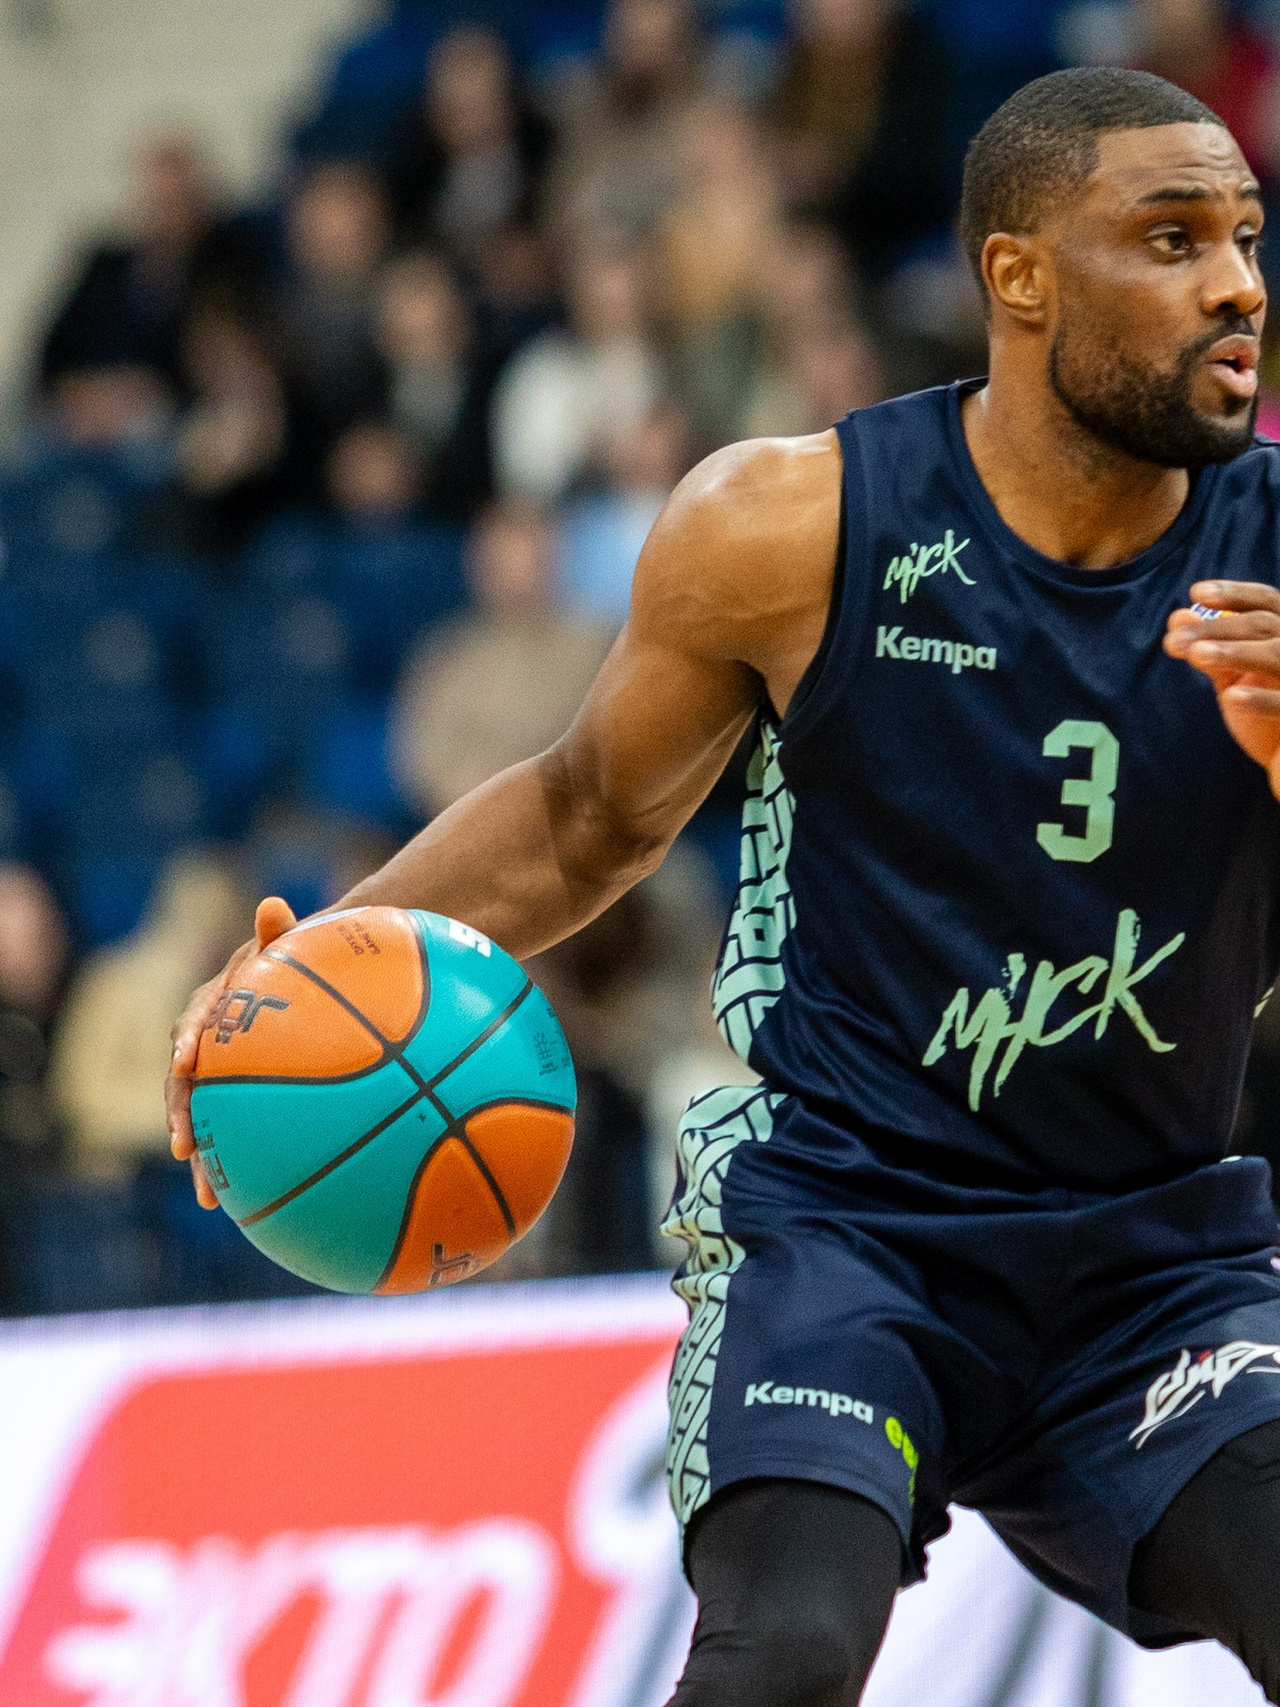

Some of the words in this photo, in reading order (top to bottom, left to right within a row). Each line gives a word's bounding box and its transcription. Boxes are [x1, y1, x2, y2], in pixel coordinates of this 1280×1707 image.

[876, 625, 996, 674] Kempa
[1036, 720, 1120, 863] 3
[744, 1380, 874, 1425] Kempa
